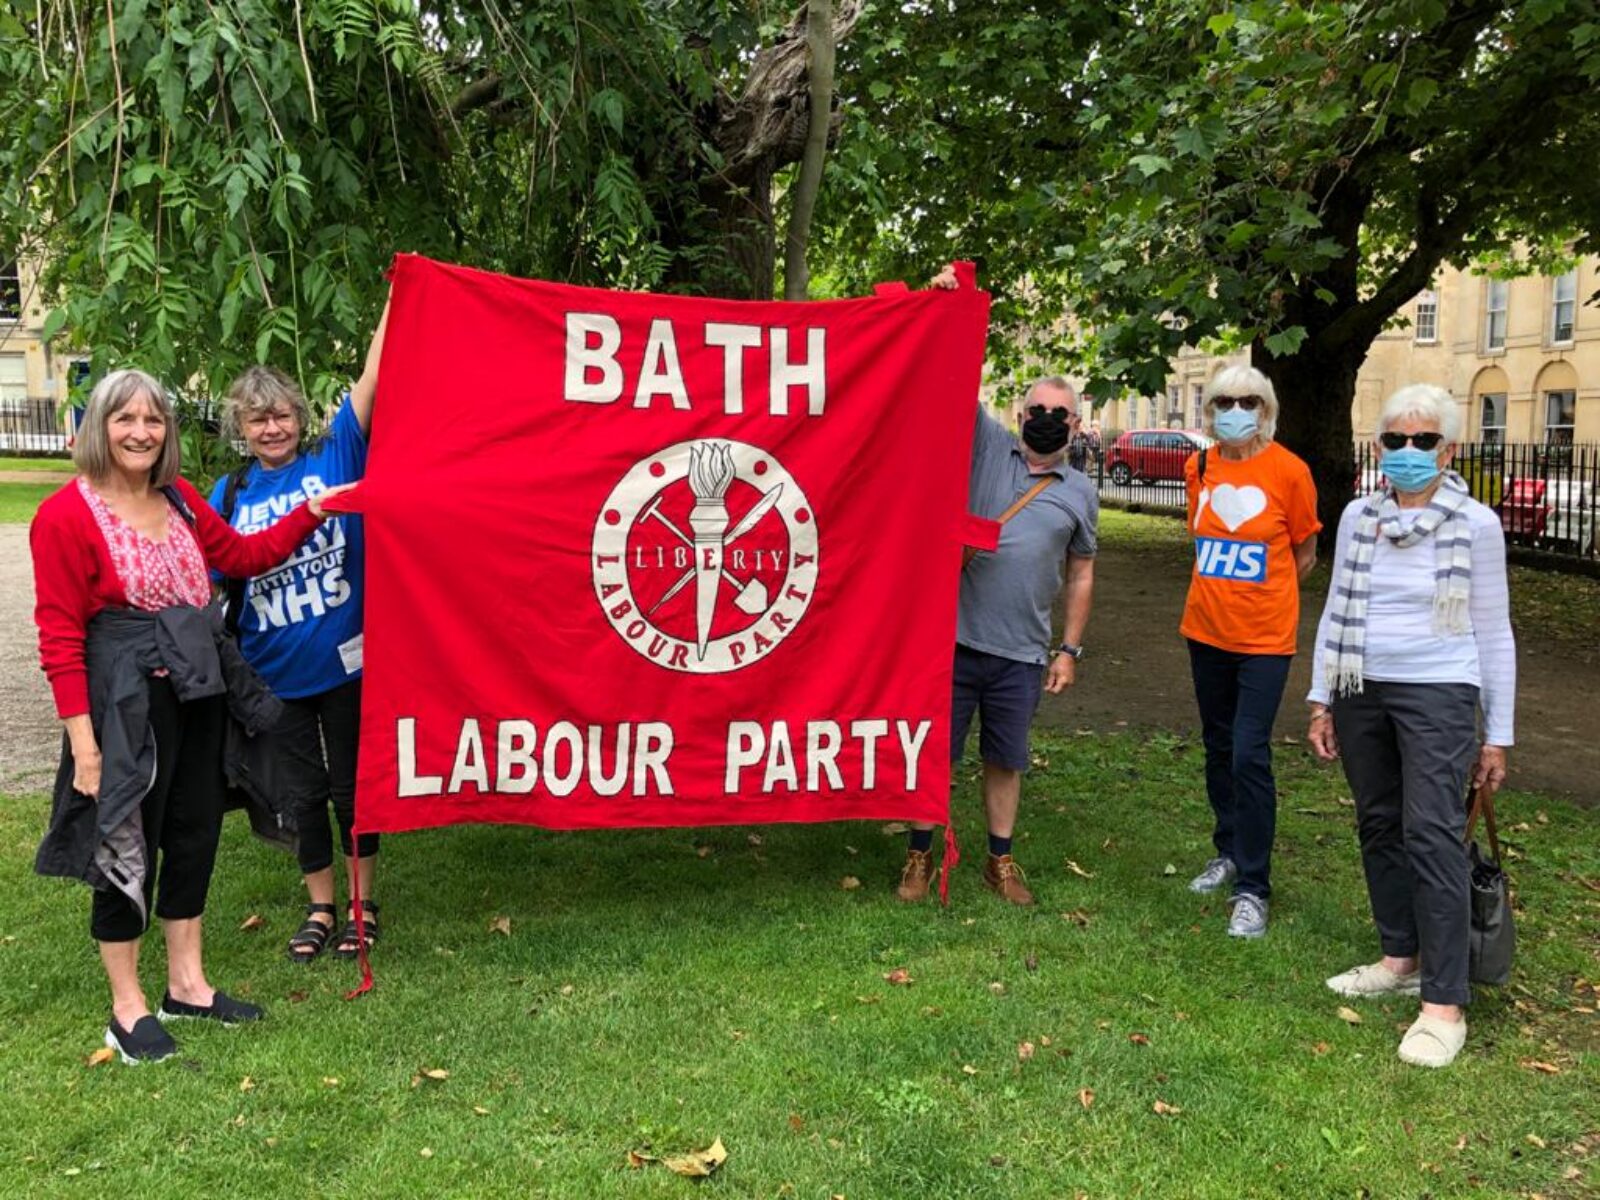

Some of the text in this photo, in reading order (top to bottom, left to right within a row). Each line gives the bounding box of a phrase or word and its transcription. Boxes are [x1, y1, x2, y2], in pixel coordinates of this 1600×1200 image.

[564, 311, 828, 417] BATH
[250, 567, 352, 632] NHS
[635, 546, 784, 572] LIBERTY
[596, 551, 815, 668] LABOUR PARTY
[396, 716, 933, 798] LABOUR PARTY
